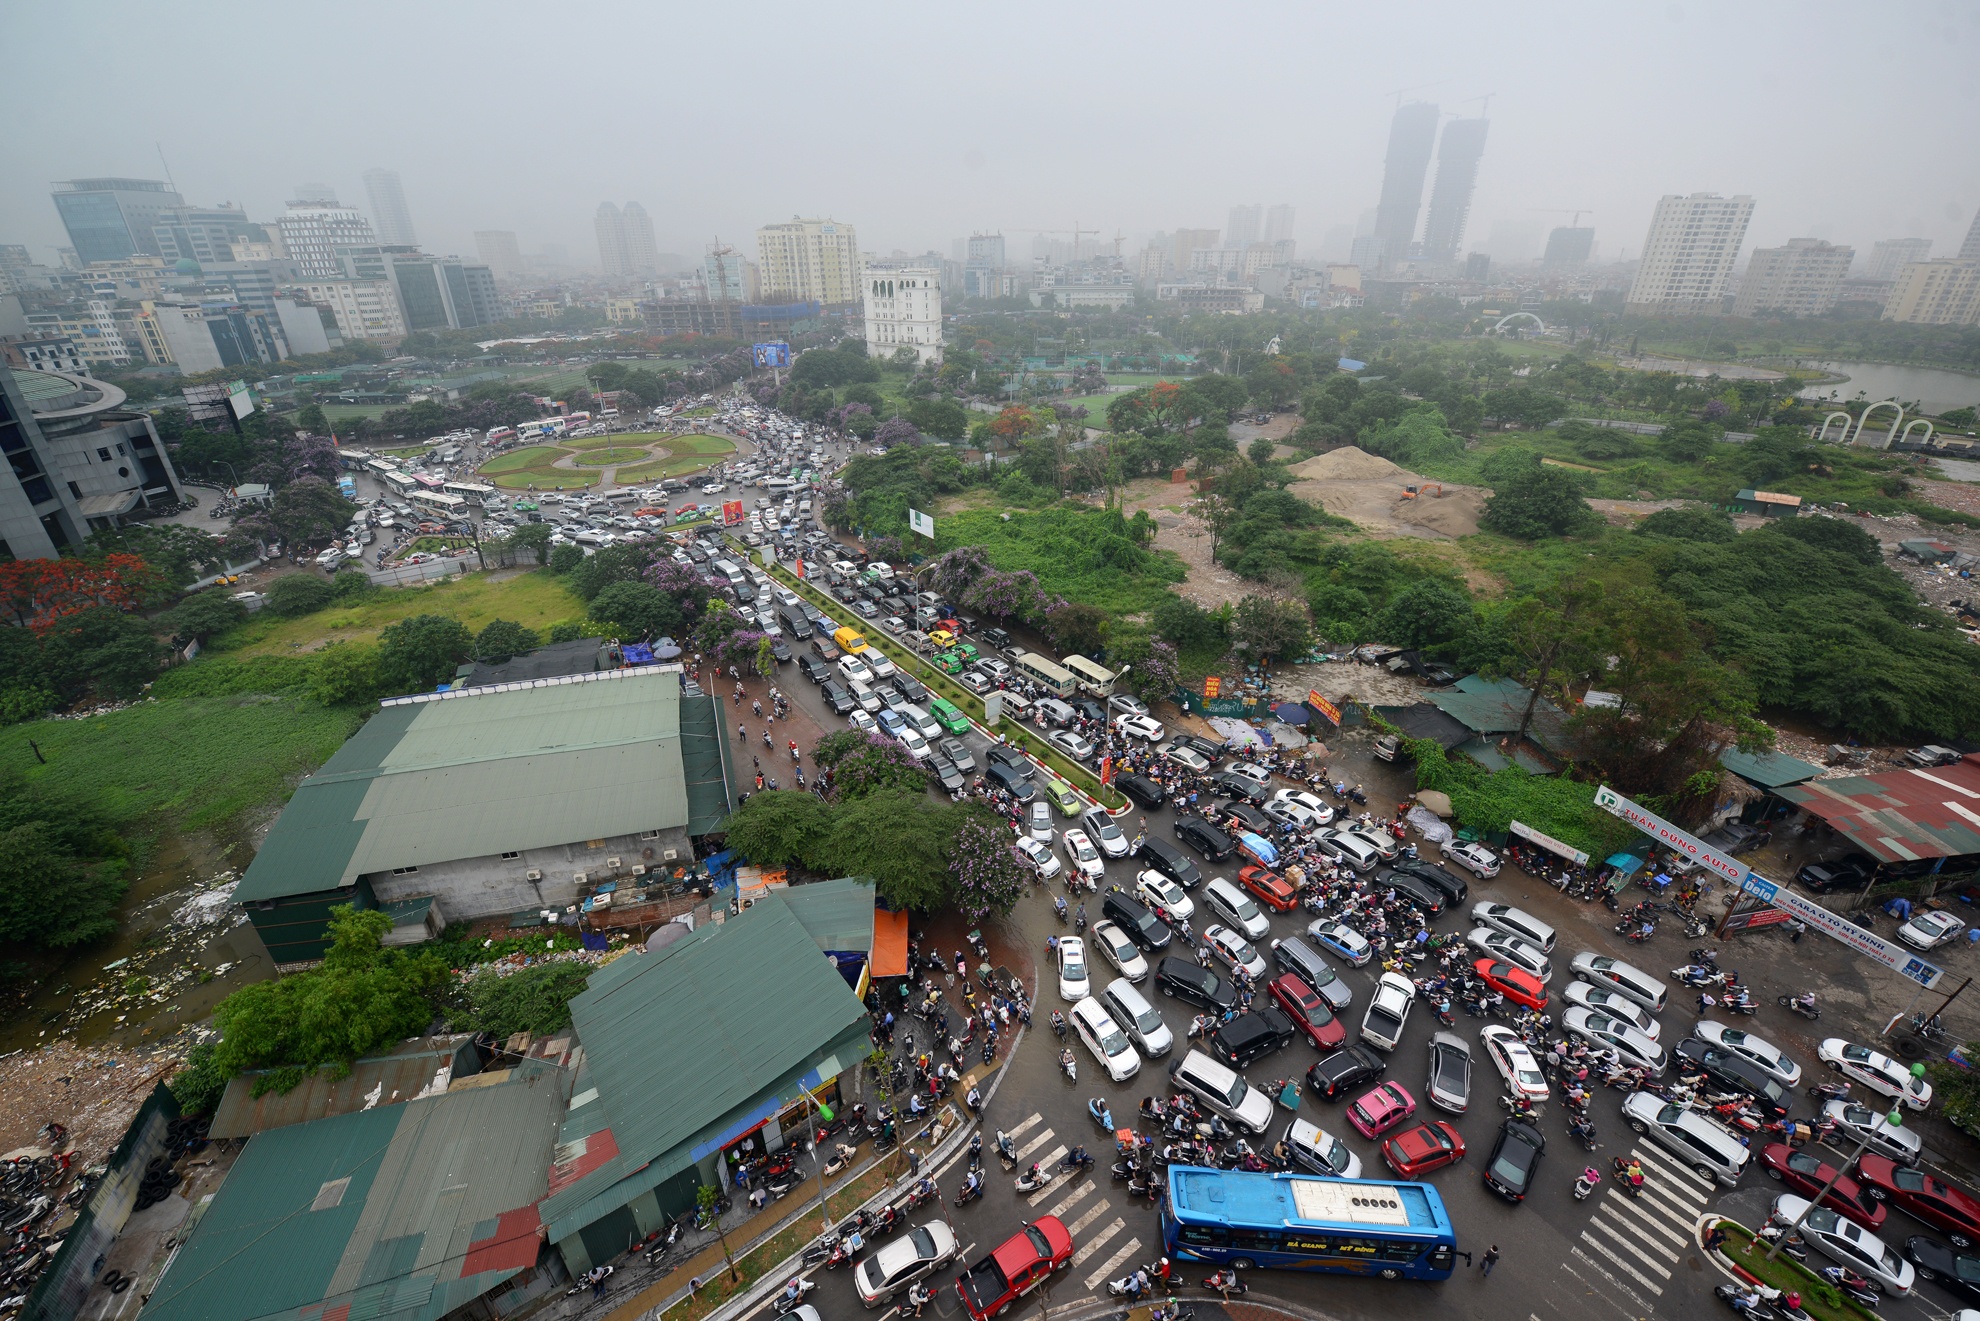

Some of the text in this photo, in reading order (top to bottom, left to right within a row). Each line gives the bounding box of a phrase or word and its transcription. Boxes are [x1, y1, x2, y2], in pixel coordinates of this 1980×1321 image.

[1625, 808, 1656, 831] TUẤN
[1660, 828, 1698, 854] DŨNG
[1702, 853, 1739, 878] AUTO
[1743, 880, 1772, 901] Delo
[1790, 898, 1885, 951] GARA Ô TÔ MỸ ĐÌNH
